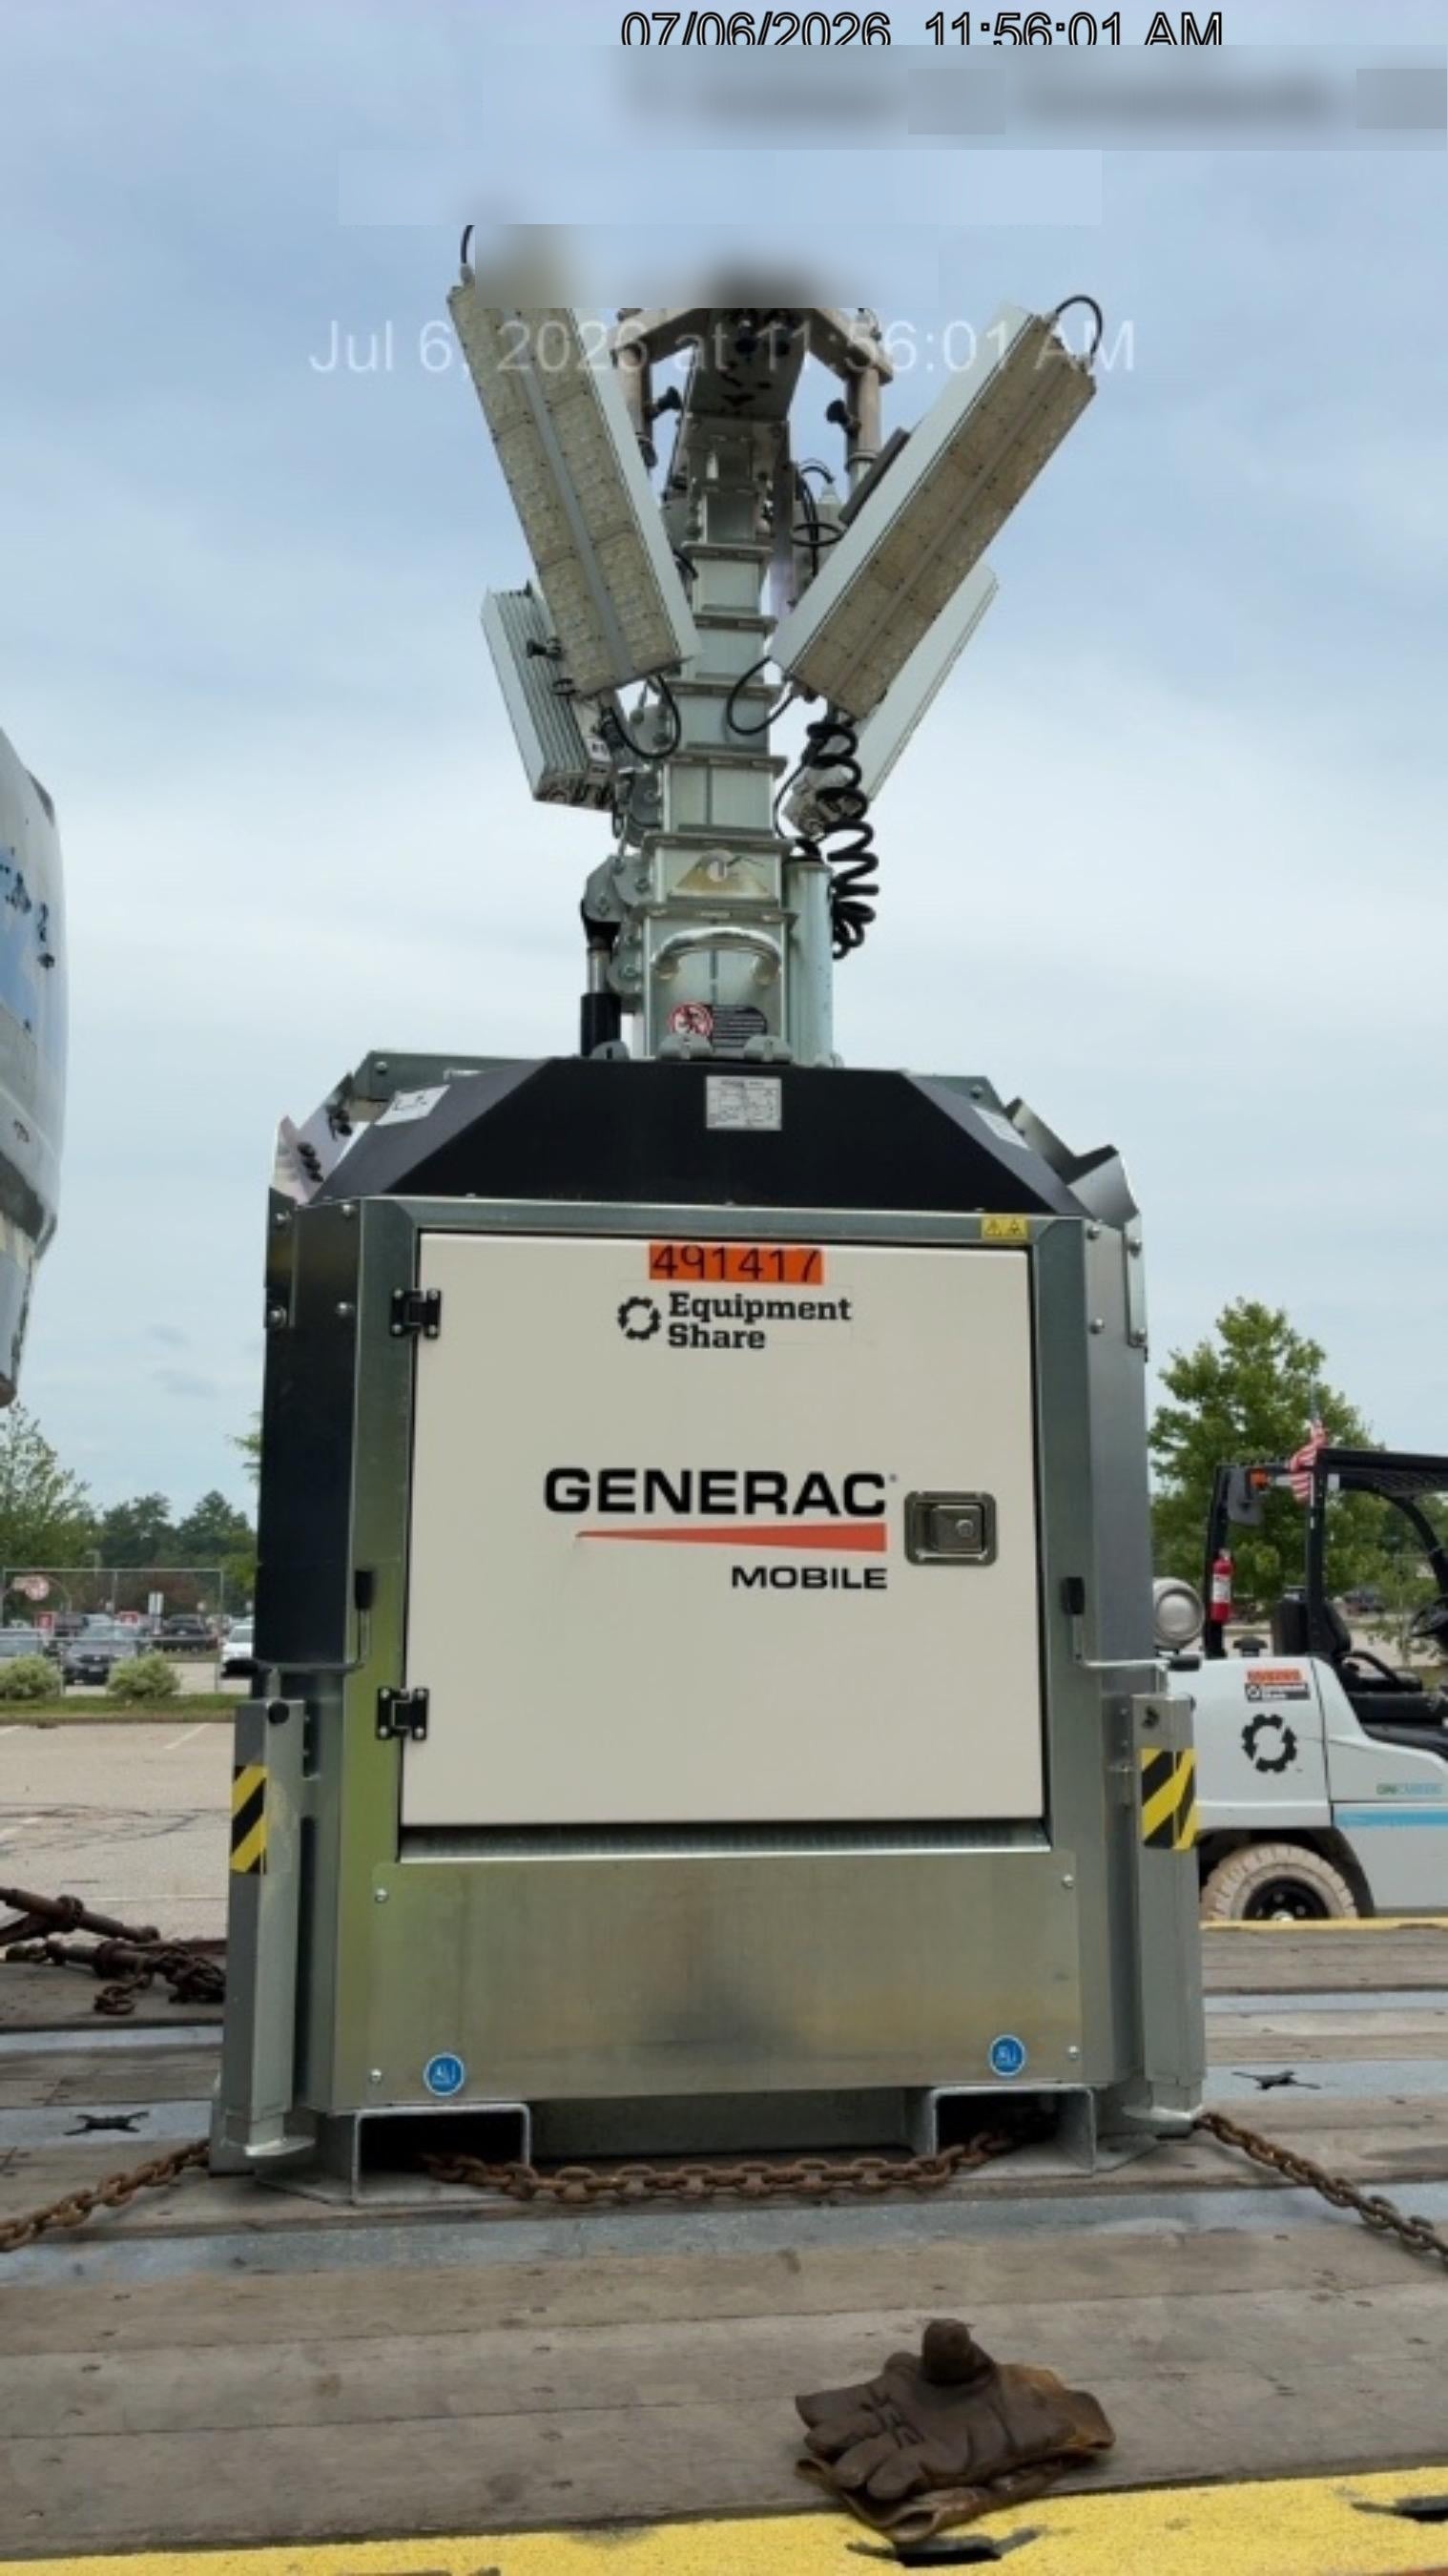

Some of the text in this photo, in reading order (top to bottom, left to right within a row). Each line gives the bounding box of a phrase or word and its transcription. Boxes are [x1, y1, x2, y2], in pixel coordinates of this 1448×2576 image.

[652, 1243, 820, 1283] 491417
[669, 1291, 853, 1324] Equipment
[668, 1322, 766, 1349] Share
[545, 1467, 887, 1517] GENERAC
[732, 1565, 888, 1589] MOBILE
